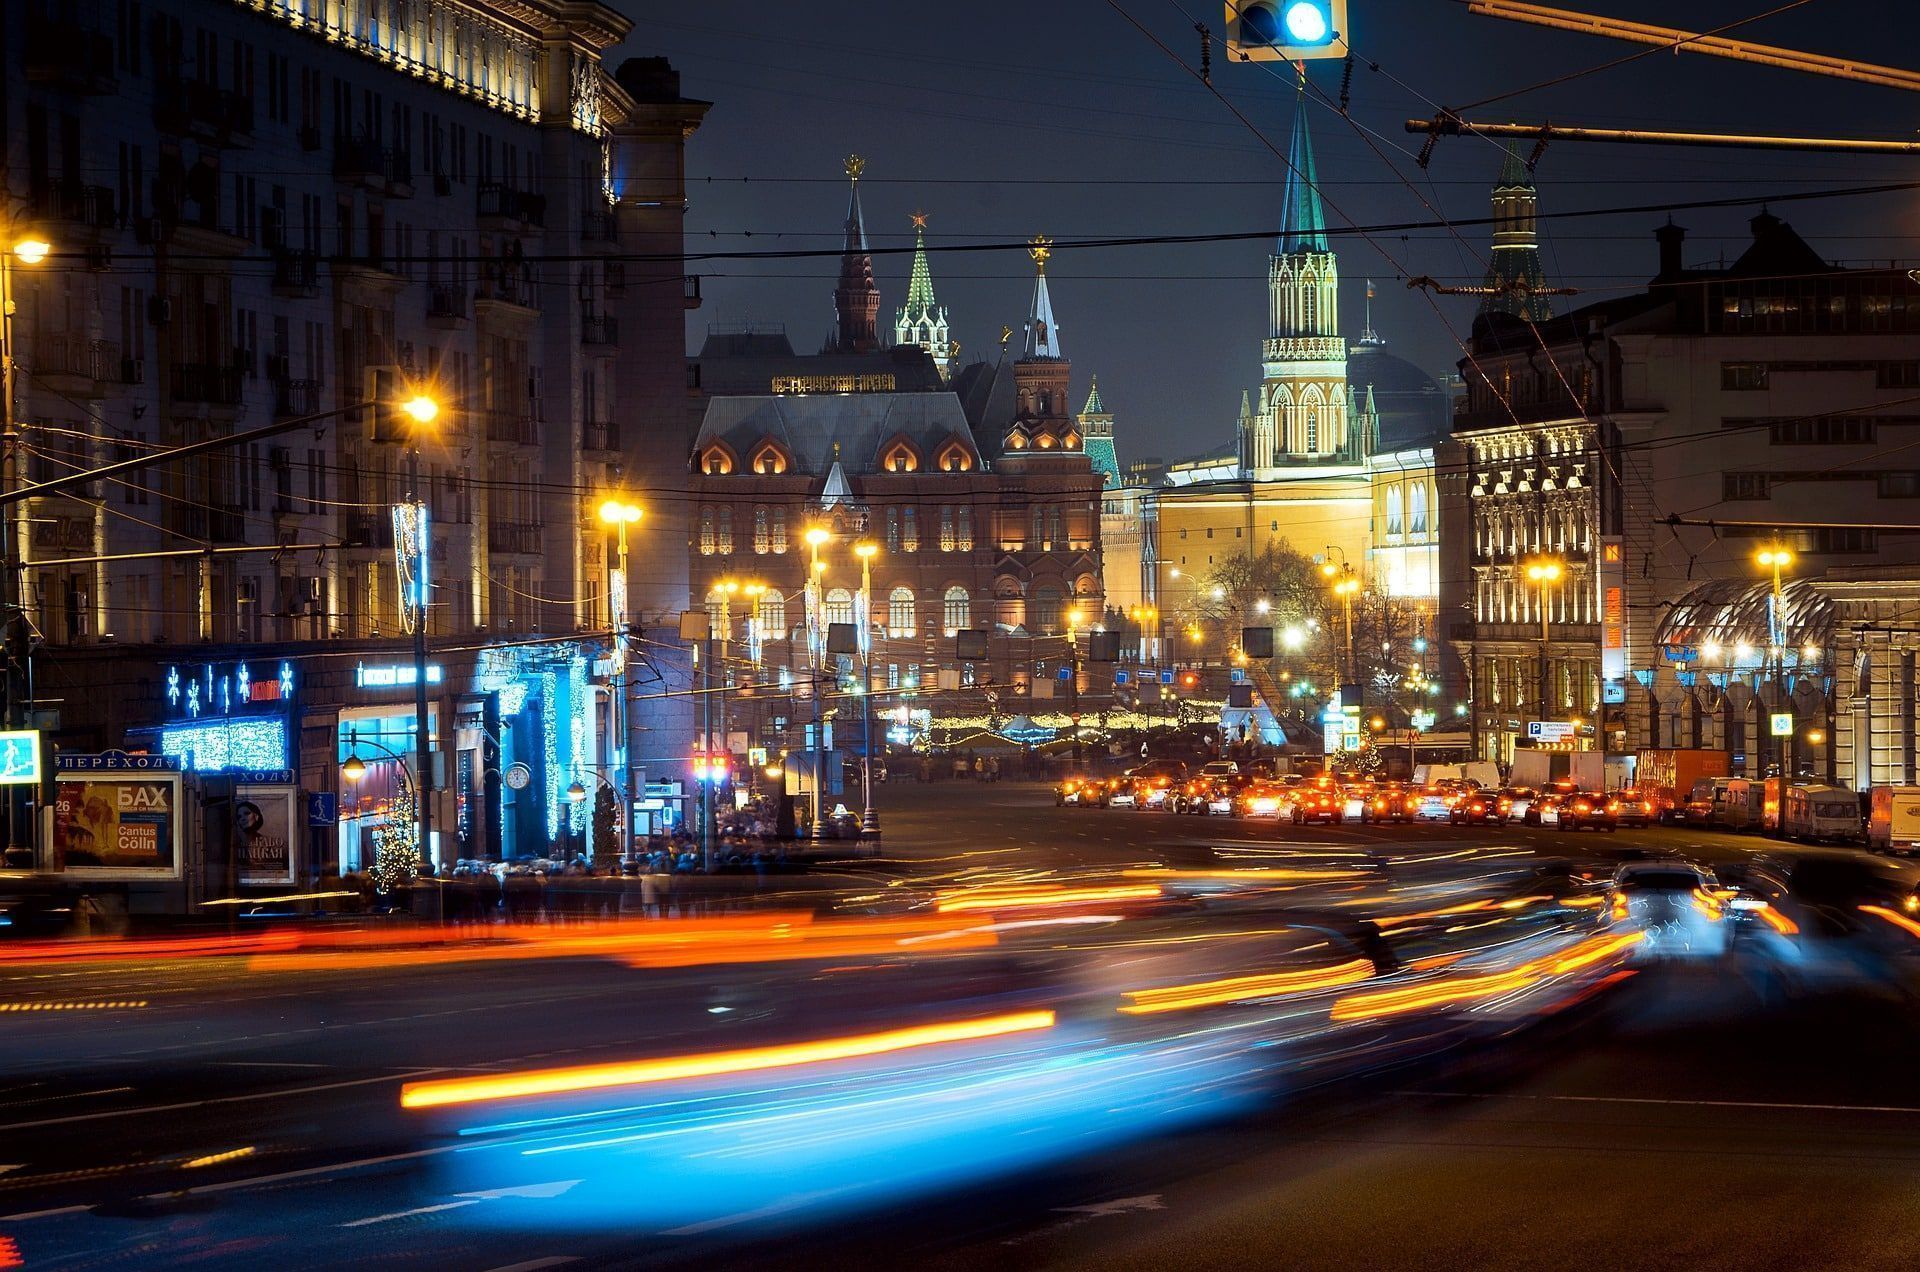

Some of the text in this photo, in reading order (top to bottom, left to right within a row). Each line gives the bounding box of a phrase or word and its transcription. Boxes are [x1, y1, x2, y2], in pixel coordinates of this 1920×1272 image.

[65, 757, 163, 768] ПЕРЕХОД
[117, 786, 168, 807] БАХ
[55, 800, 70, 812] 26
[118, 825, 156, 837] Cantus
[118, 836, 156, 850] Cölln
